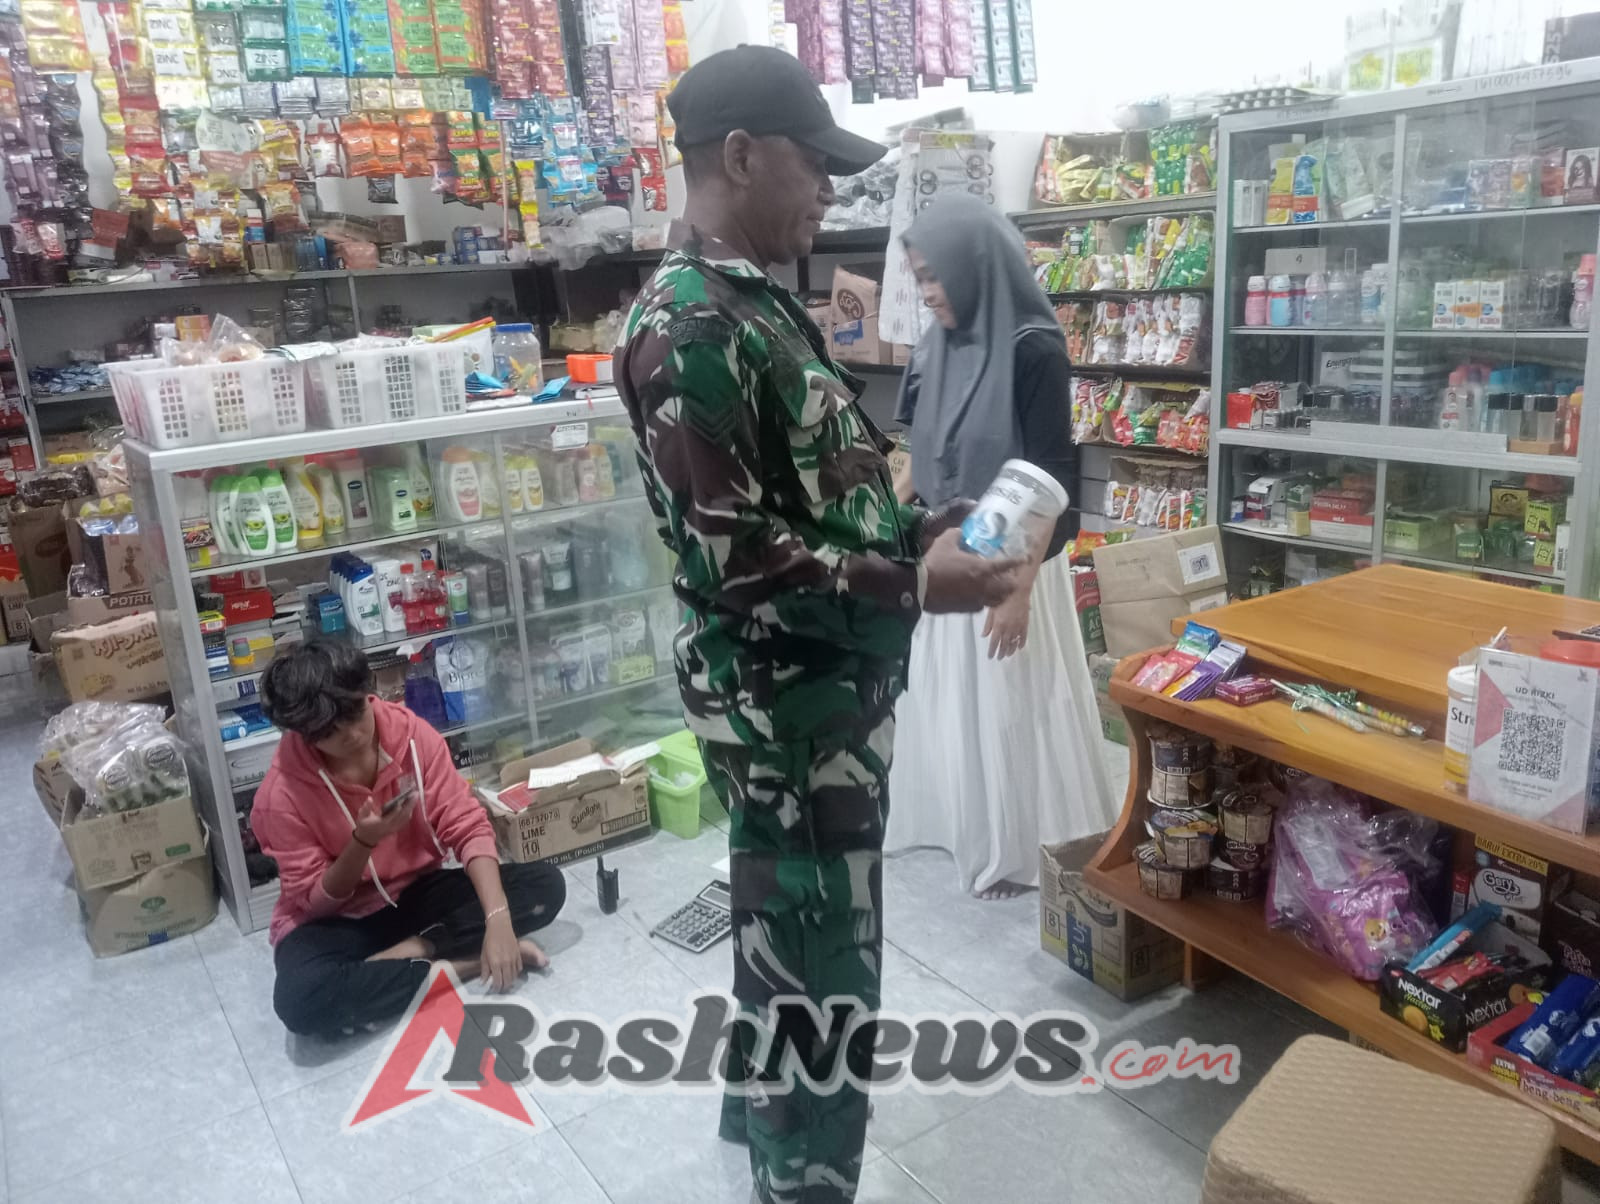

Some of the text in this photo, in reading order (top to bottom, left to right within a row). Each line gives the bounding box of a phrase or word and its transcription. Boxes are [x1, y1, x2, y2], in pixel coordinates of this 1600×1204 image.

[156, 54, 179, 65] ZINC
[253, 53, 279, 64] ZINC
[570, 801, 600, 830] Sunlight
[521, 825, 546, 840] LIME
[524, 841, 538, 856] 10
[575, 841, 605, 858] (Pouch)
[1501, 845, 1527, 863] EXTRA
